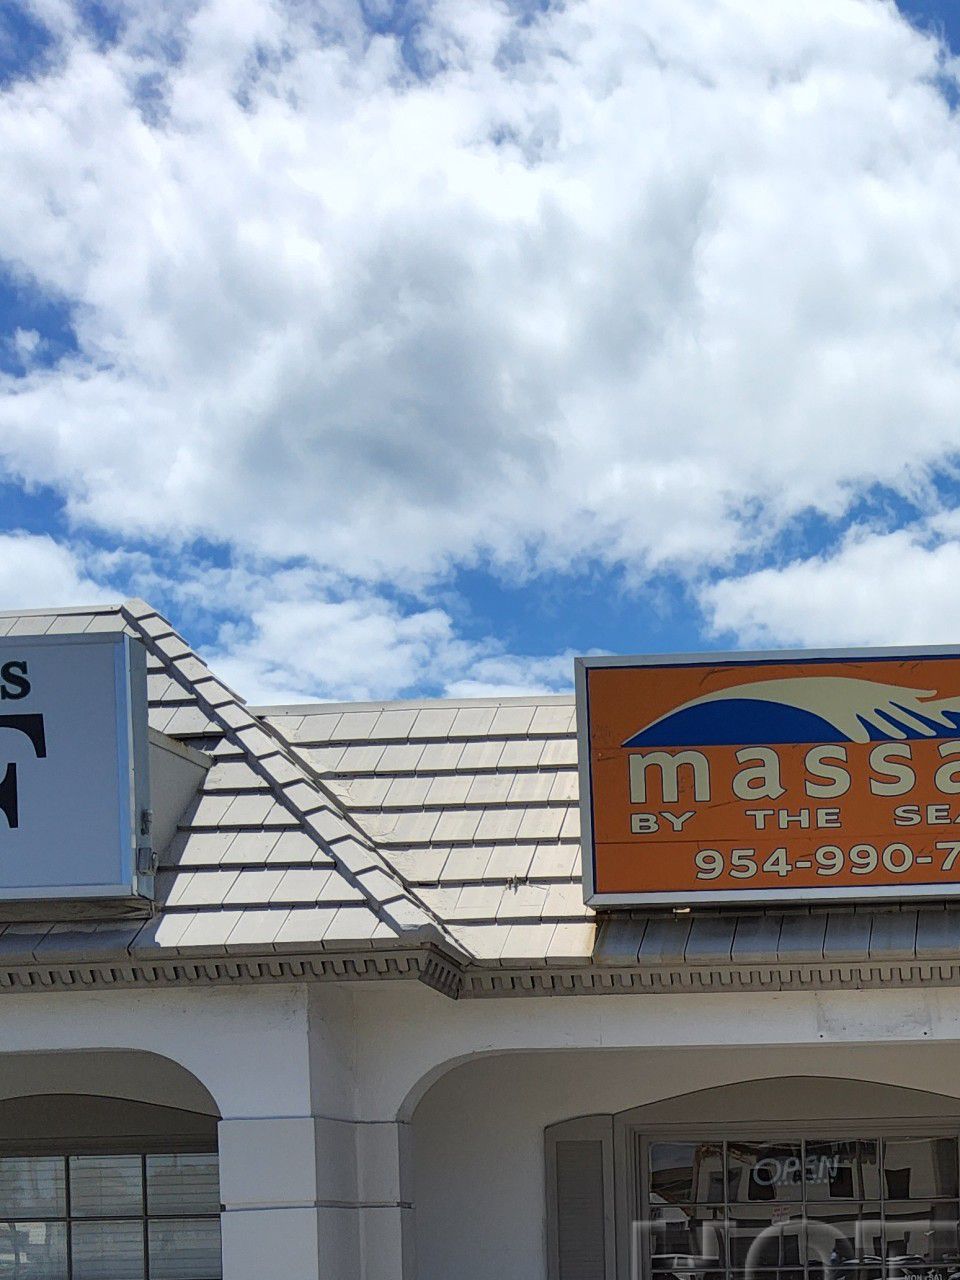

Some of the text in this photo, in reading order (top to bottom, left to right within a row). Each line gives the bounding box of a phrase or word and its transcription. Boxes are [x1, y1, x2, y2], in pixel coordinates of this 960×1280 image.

[630, 811, 697, 834] BY
[745, 808, 842, 830] THE
[753, 1155, 840, 1186] OPEN
